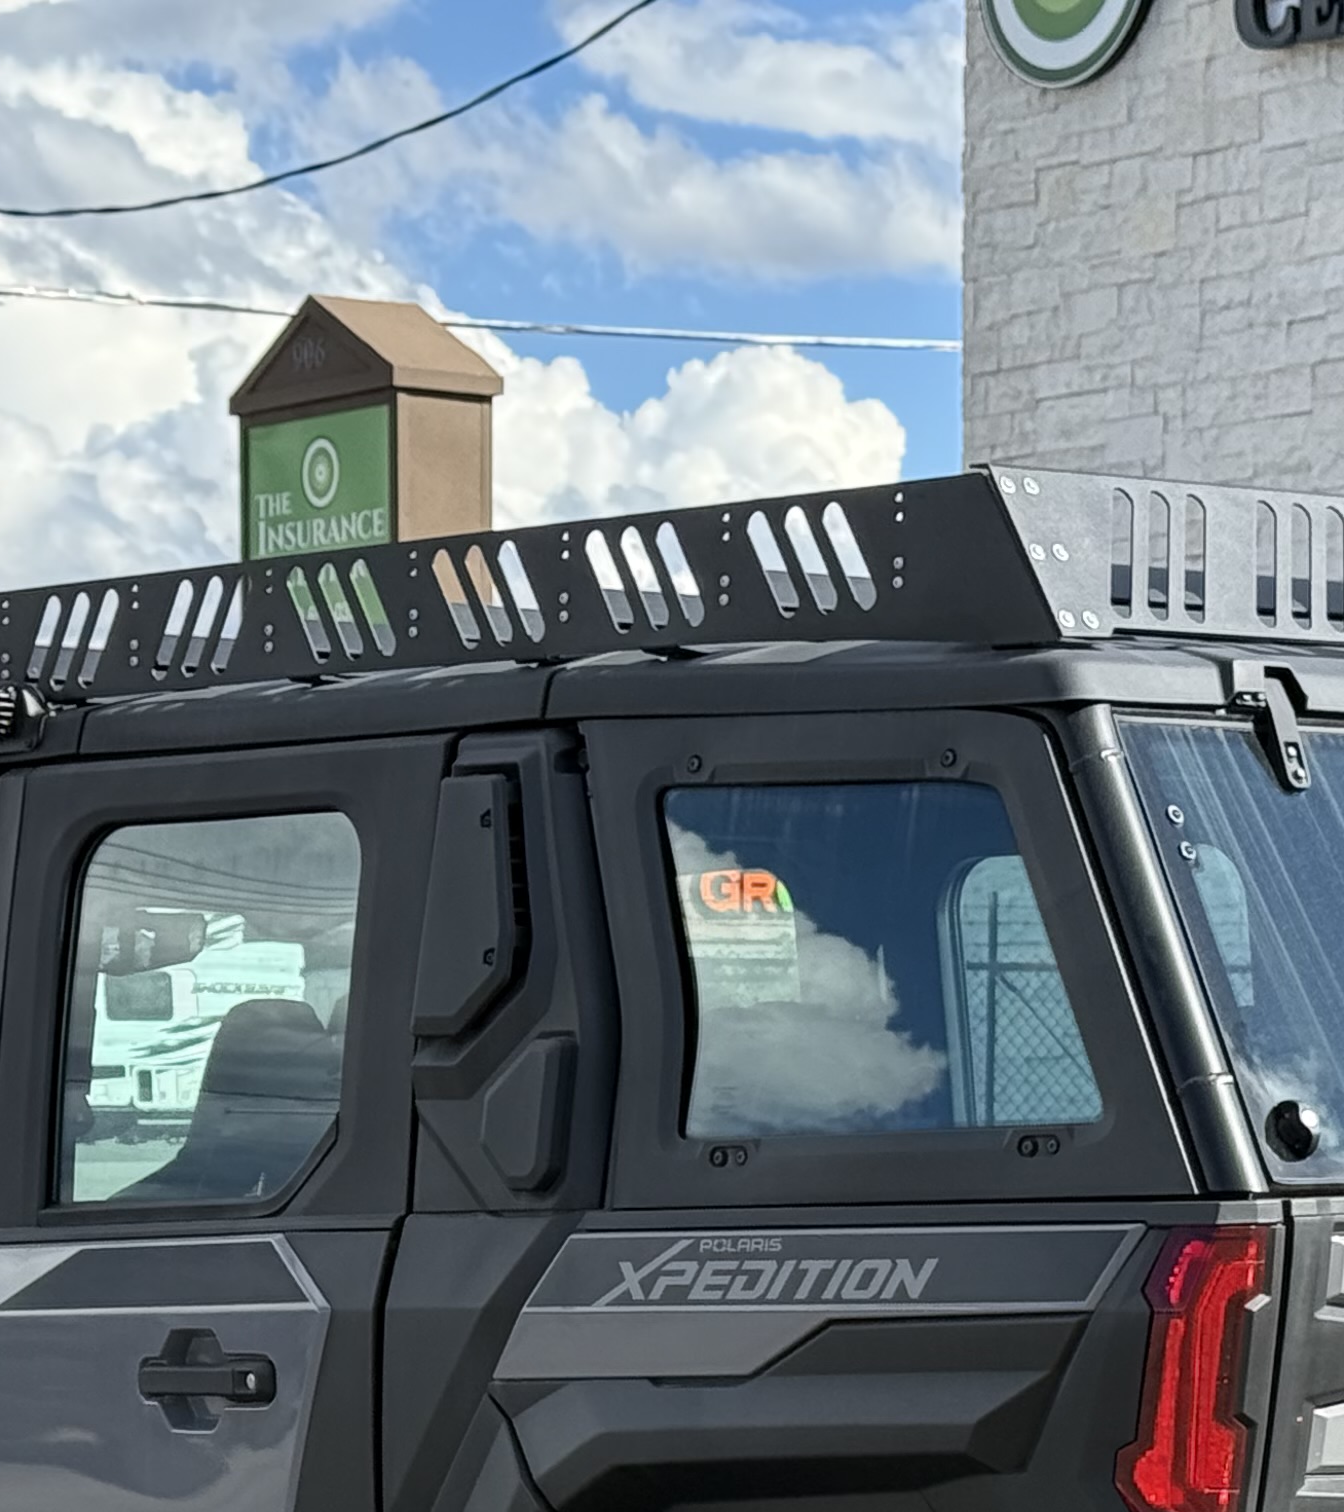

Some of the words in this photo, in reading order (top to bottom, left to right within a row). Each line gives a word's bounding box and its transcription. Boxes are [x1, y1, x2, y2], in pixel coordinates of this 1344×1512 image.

[292, 335, 326, 371] 906
[254, 491, 292, 518] THE
[256, 507, 386, 556] INSURANCE
[699, 1237, 783, 1253] POLARIS
[591, 1239, 940, 1307] XPEDITION
